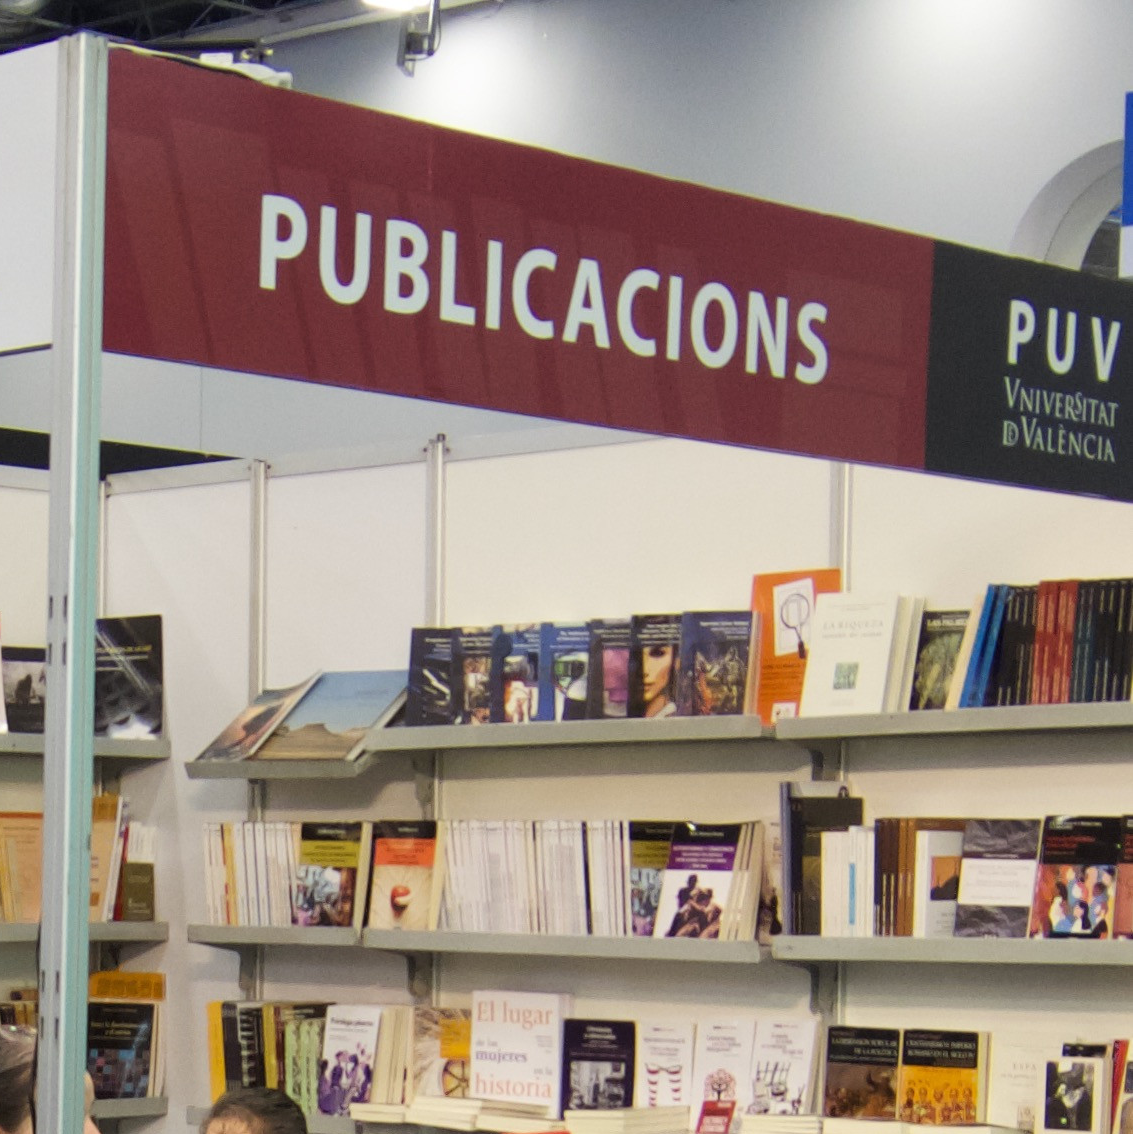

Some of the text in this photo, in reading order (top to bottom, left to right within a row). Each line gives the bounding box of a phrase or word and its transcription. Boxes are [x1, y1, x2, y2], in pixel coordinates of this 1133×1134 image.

[259, 194, 828, 384] PUBLICACIONS
[1021, 416, 1116, 463] VALÈNCIA
[477, 1000, 553, 1031] El lugar
[475, 1048, 528, 1064] mujeres
[475, 1072, 553, 1098] historia
